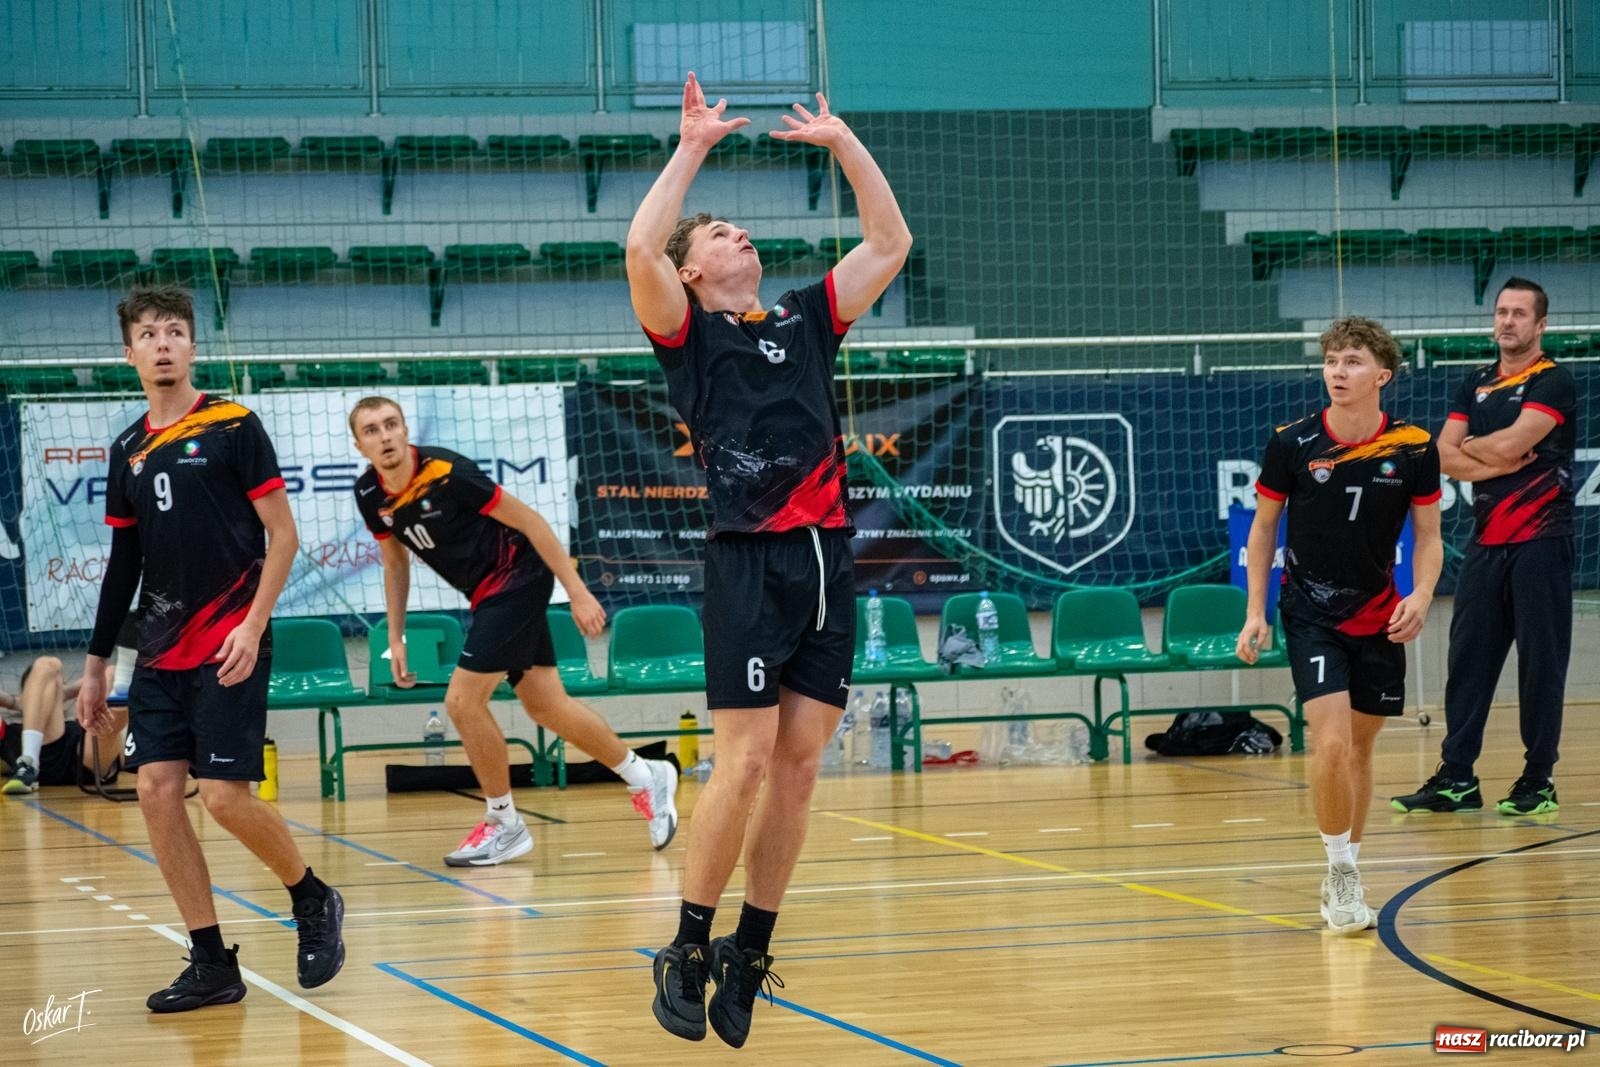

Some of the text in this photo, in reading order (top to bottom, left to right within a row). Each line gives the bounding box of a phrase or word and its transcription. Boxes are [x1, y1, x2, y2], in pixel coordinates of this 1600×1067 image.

[153, 472, 173, 512] 9
[597, 485, 640, 498] STAL
[643, 485, 709, 499] NIERDZ
[1345, 486, 1363, 521] 7
[403, 523, 436, 550] 10
[598, 528, 663, 539] BALUSTRADY
[747, 656, 766, 692] 6
[1309, 655, 1325, 683] 7
